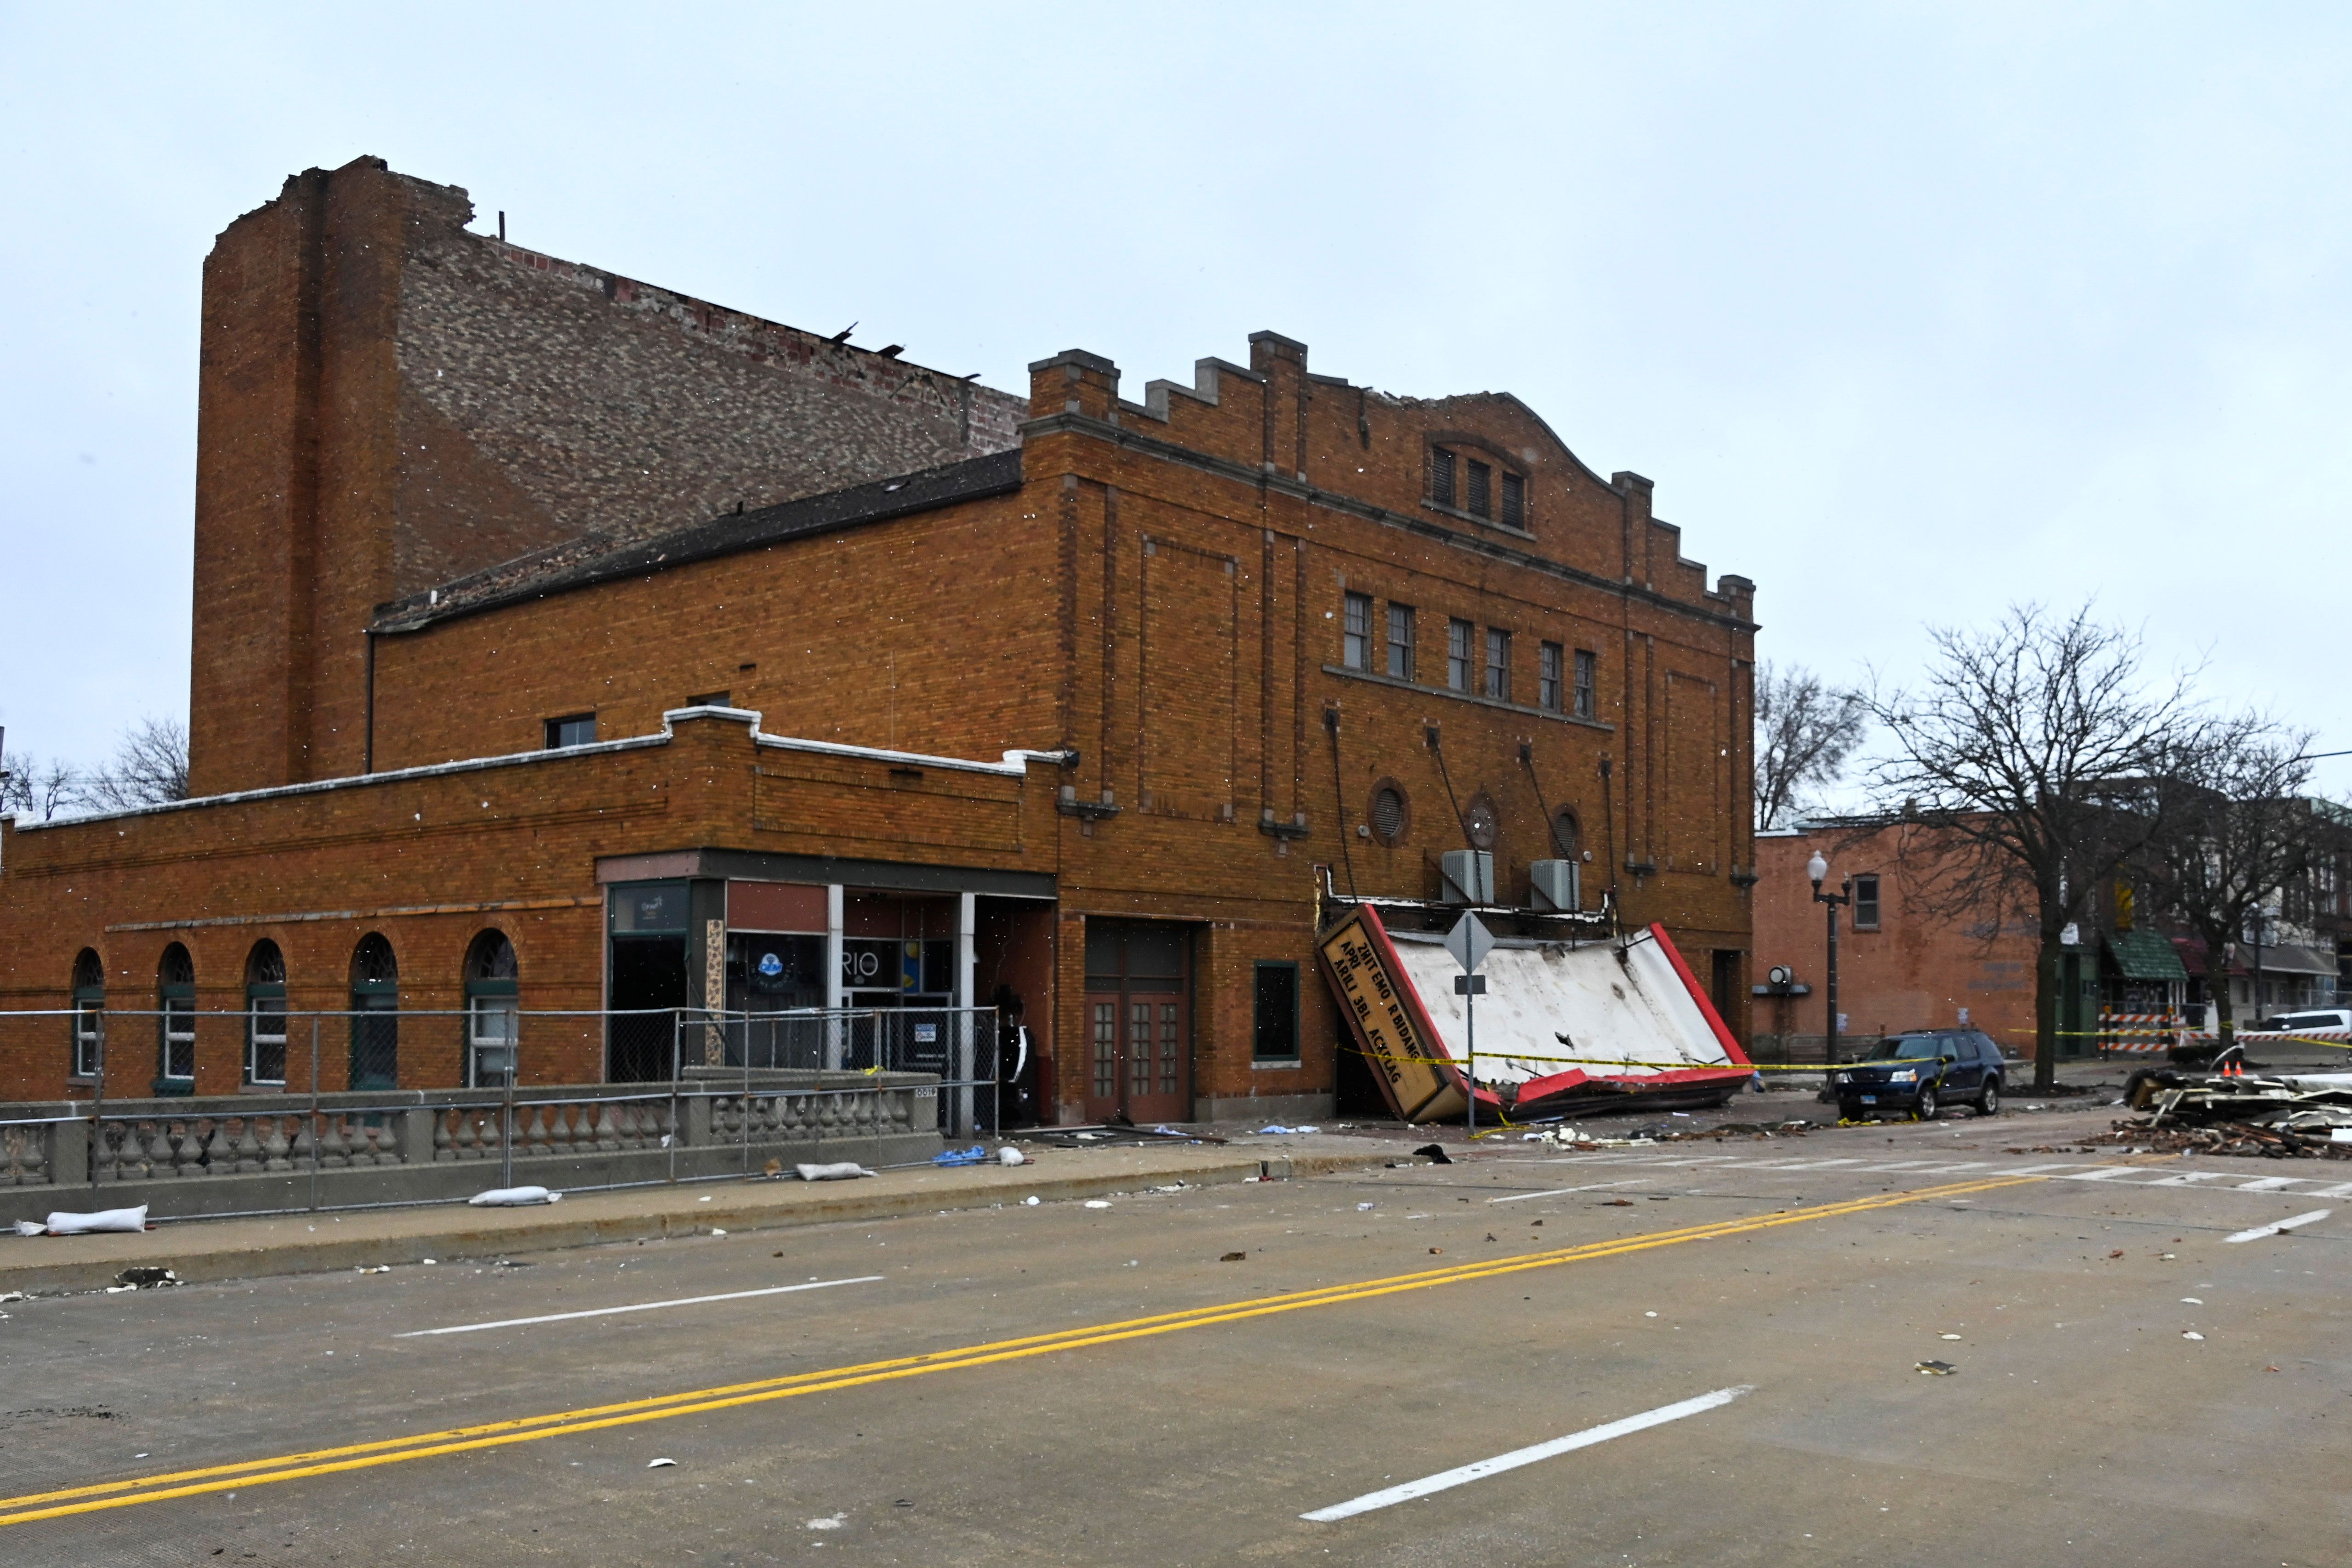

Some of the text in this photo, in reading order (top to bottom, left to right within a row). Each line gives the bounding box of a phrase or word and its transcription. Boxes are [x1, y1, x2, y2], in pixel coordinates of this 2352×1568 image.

[1340, 941, 1361, 969] APRI
[1334, 959, 1357, 992] ARILI
[1353, 996, 1371, 1022] 3BL
[1372, 972, 1391, 999] EMO
